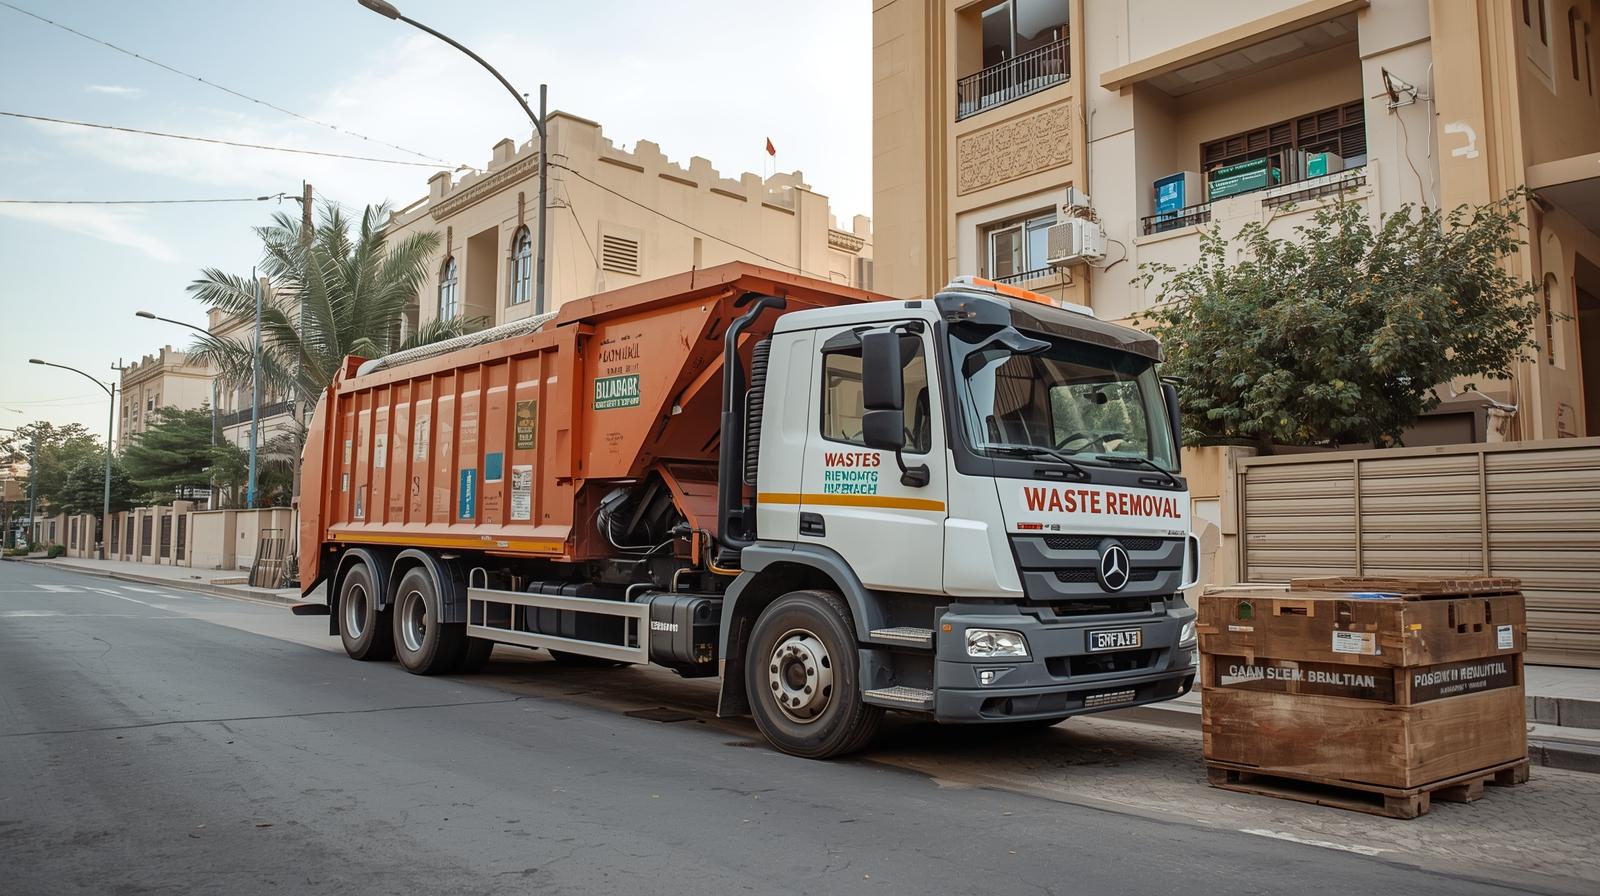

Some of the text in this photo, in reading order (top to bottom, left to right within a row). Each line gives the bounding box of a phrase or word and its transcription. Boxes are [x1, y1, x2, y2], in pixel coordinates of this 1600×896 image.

[824, 452, 881, 468] WASTES
[1024, 486, 1181, 519] WASTE REMOVAL
